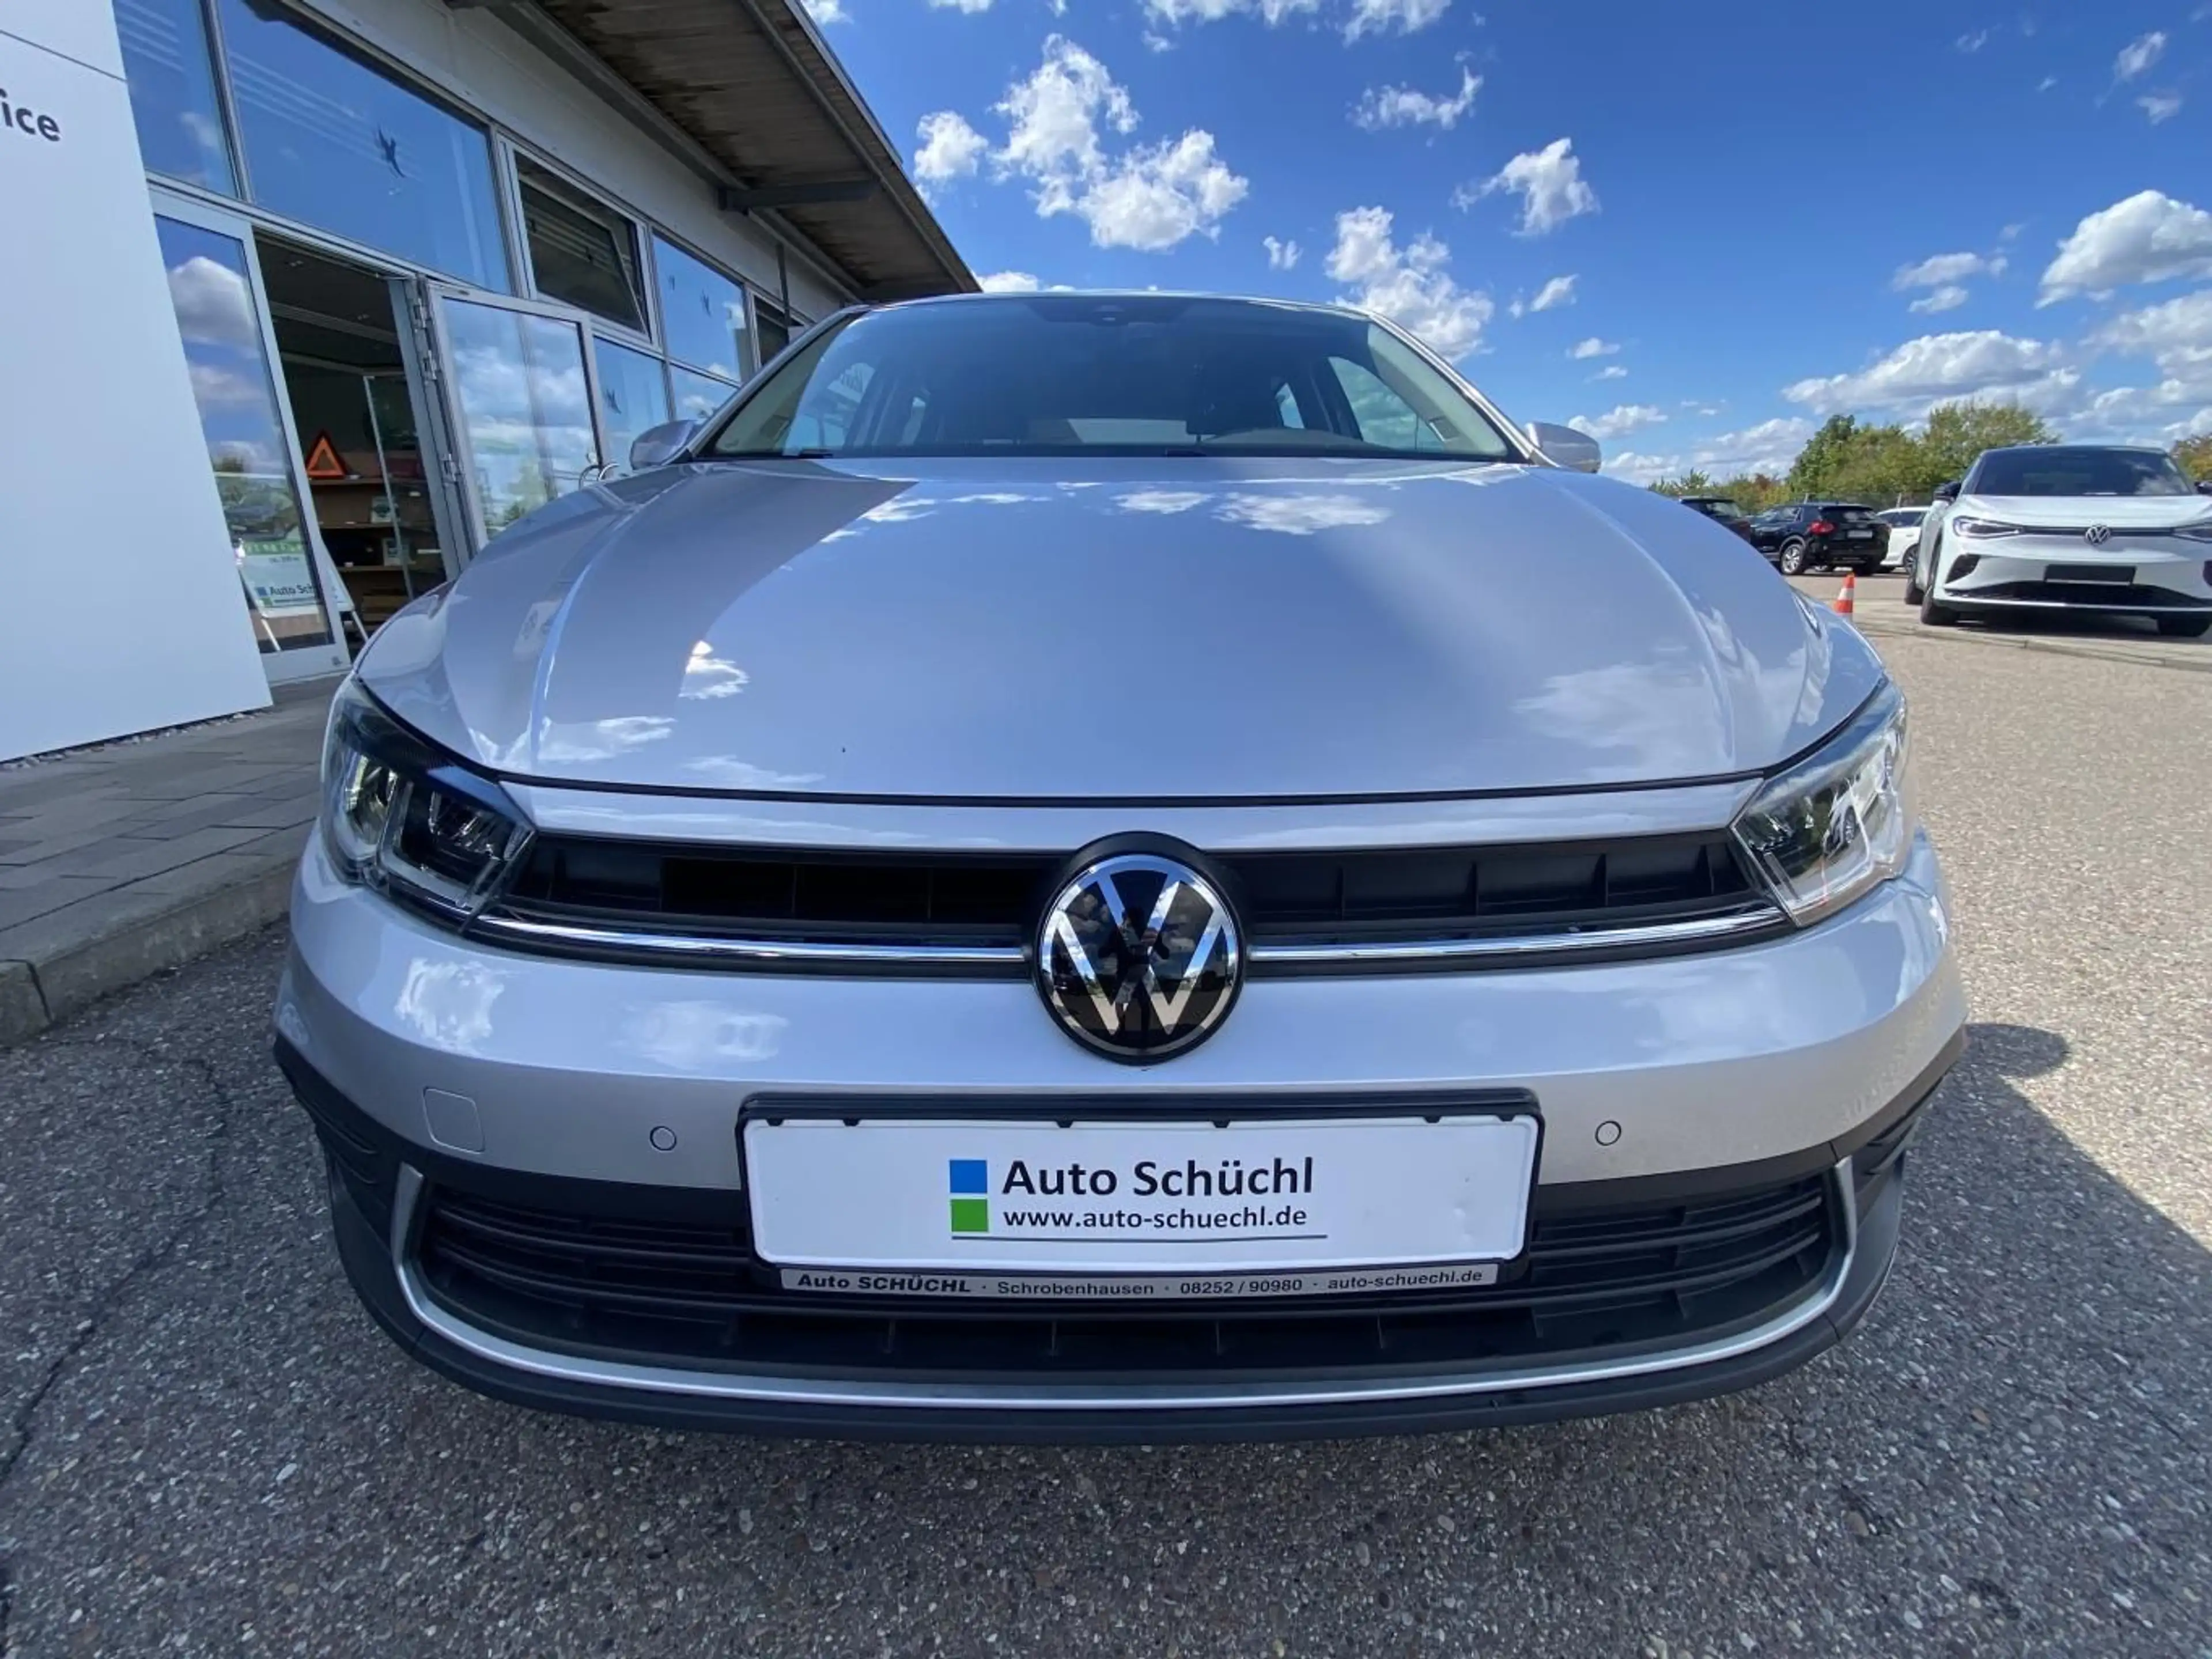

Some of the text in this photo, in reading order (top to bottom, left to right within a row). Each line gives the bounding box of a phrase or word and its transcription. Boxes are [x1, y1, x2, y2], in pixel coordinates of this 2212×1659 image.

[1002, 1157, 1313, 1196] Auto Schüchl
[1004, 1206, 1307, 1229] www.auto-schuechl.de
[797, 1274, 850, 1288] Auto
[857, 1275, 971, 1293] SCHÜCHL
[997, 1281, 1155, 1294] Schrobenhausen
[1328, 1270, 1483, 1290] auto-schuechl.de
